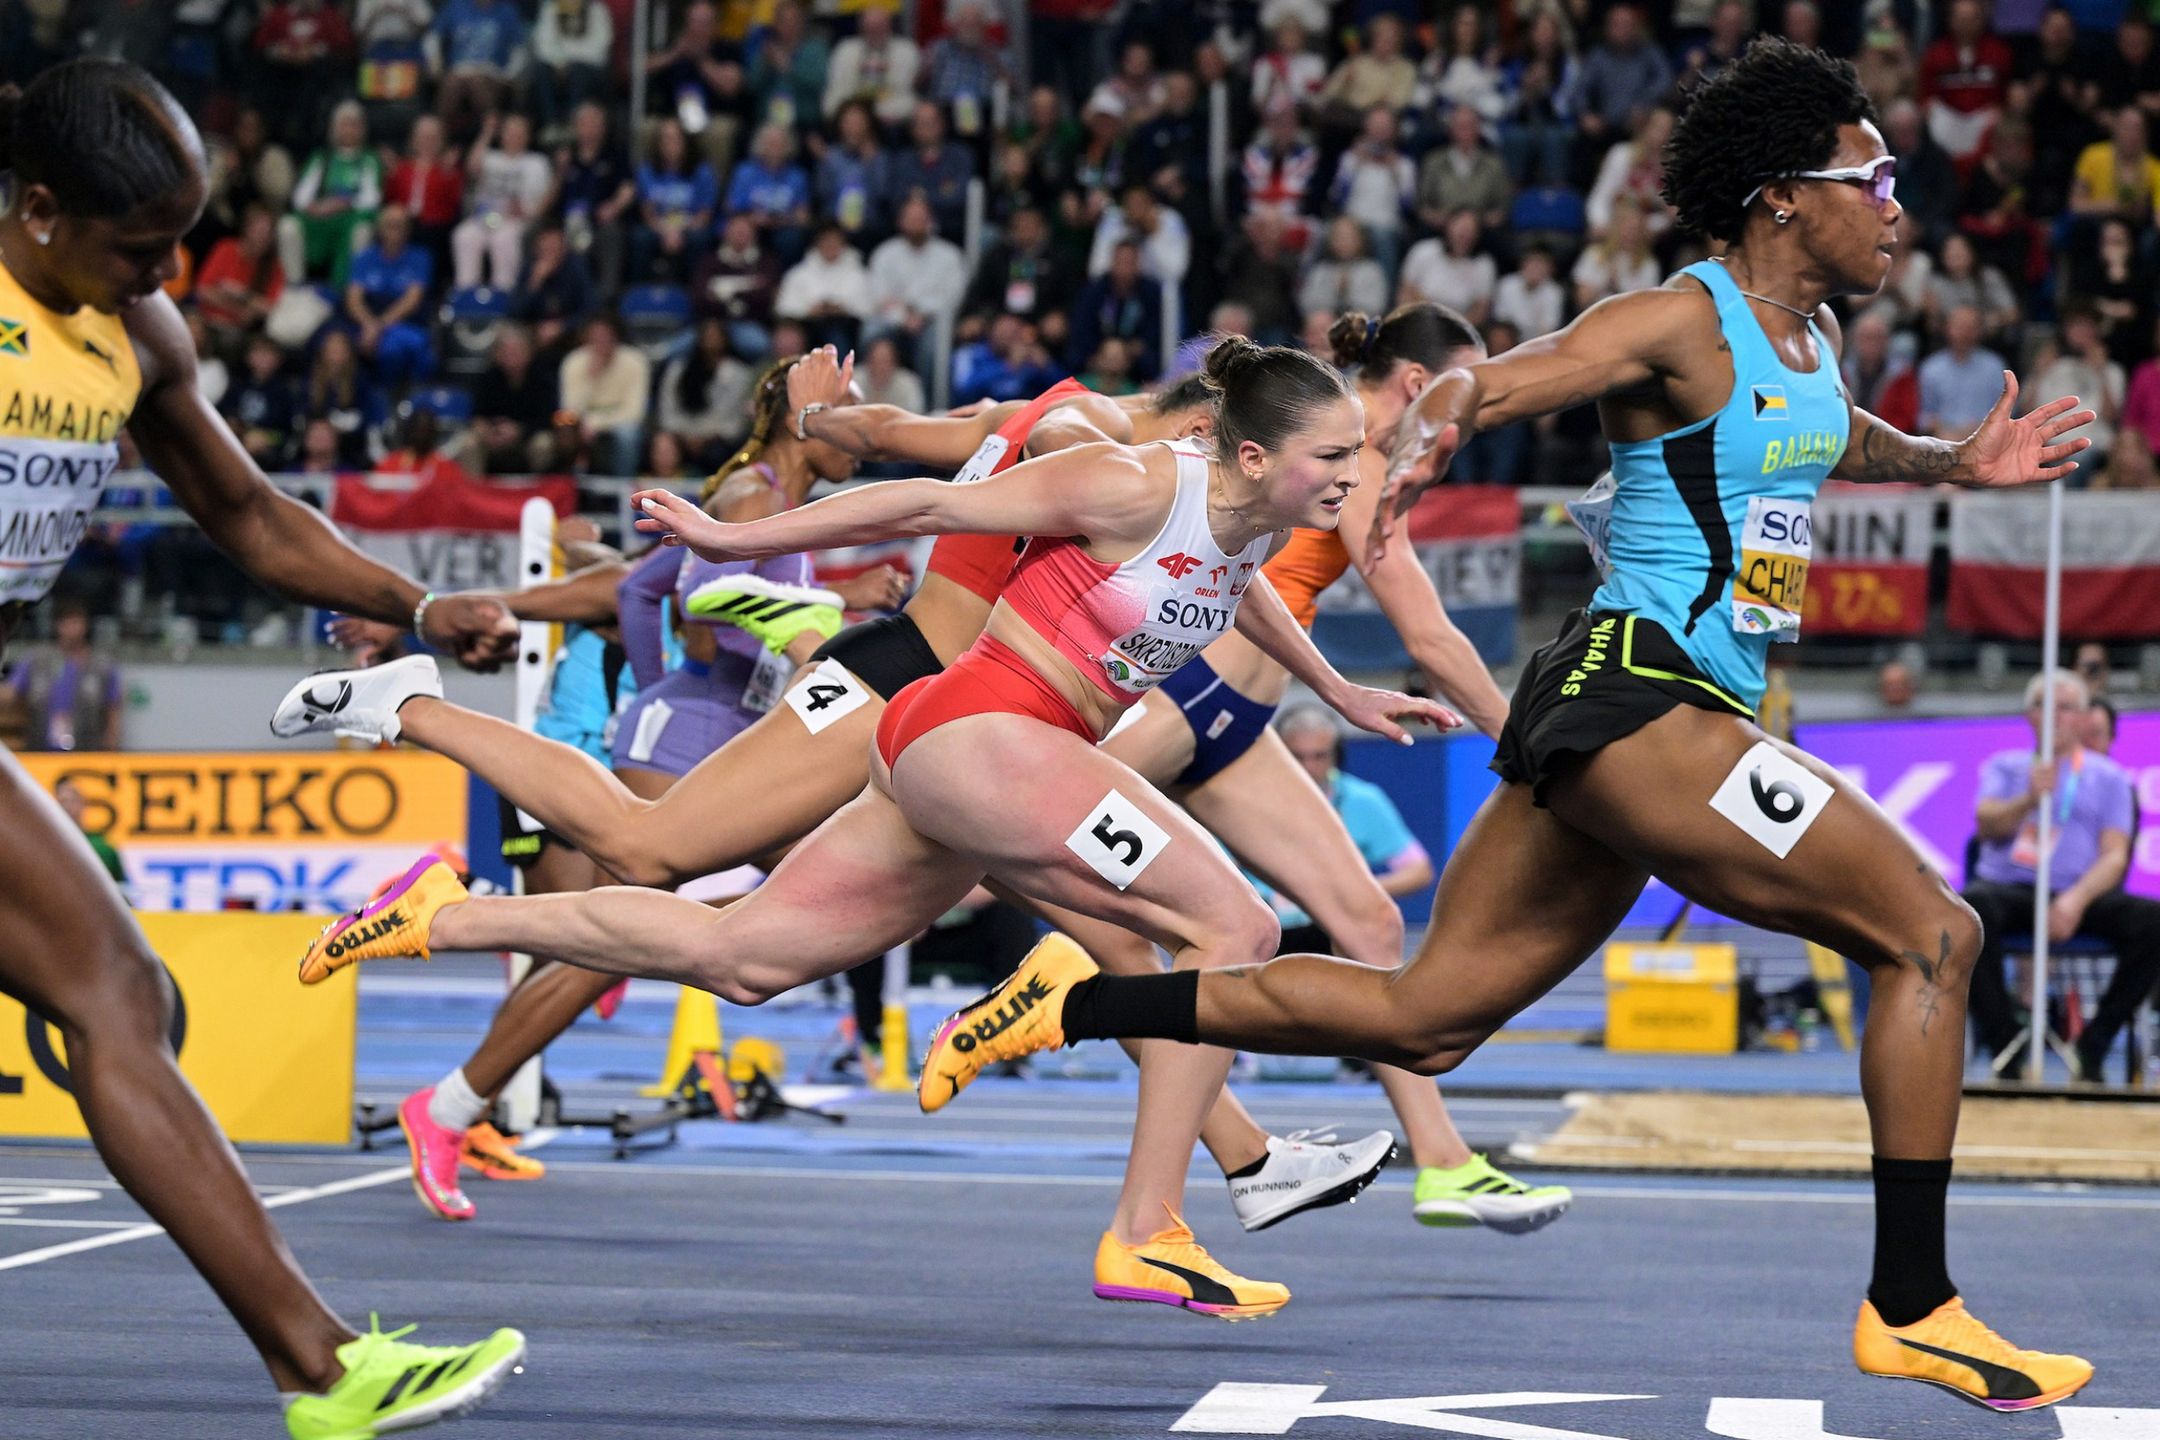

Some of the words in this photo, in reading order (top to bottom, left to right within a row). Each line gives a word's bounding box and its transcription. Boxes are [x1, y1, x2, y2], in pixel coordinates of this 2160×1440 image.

[4, 390, 128, 443] AMAIC
[0, 450, 115, 489] SONY
[1760, 510, 1813, 546] SON
[1156, 552, 1204, 580] 4F
[1194, 587, 1220, 599] ORLEN
[1158, 599, 1234, 632] SONY
[806, 684, 849, 712] 4
[54, 766, 399, 837] SEIKO
[1749, 764, 1805, 824] 6
[1090, 813, 1143, 867] 5
[143, 857, 358, 913] TDK
[325, 910, 411, 957] NITRO
[952, 971, 1058, 1052] NITRO
[1233, 1186, 1249, 1199] ON
[1251, 1179, 1302, 1194] RUNNING
